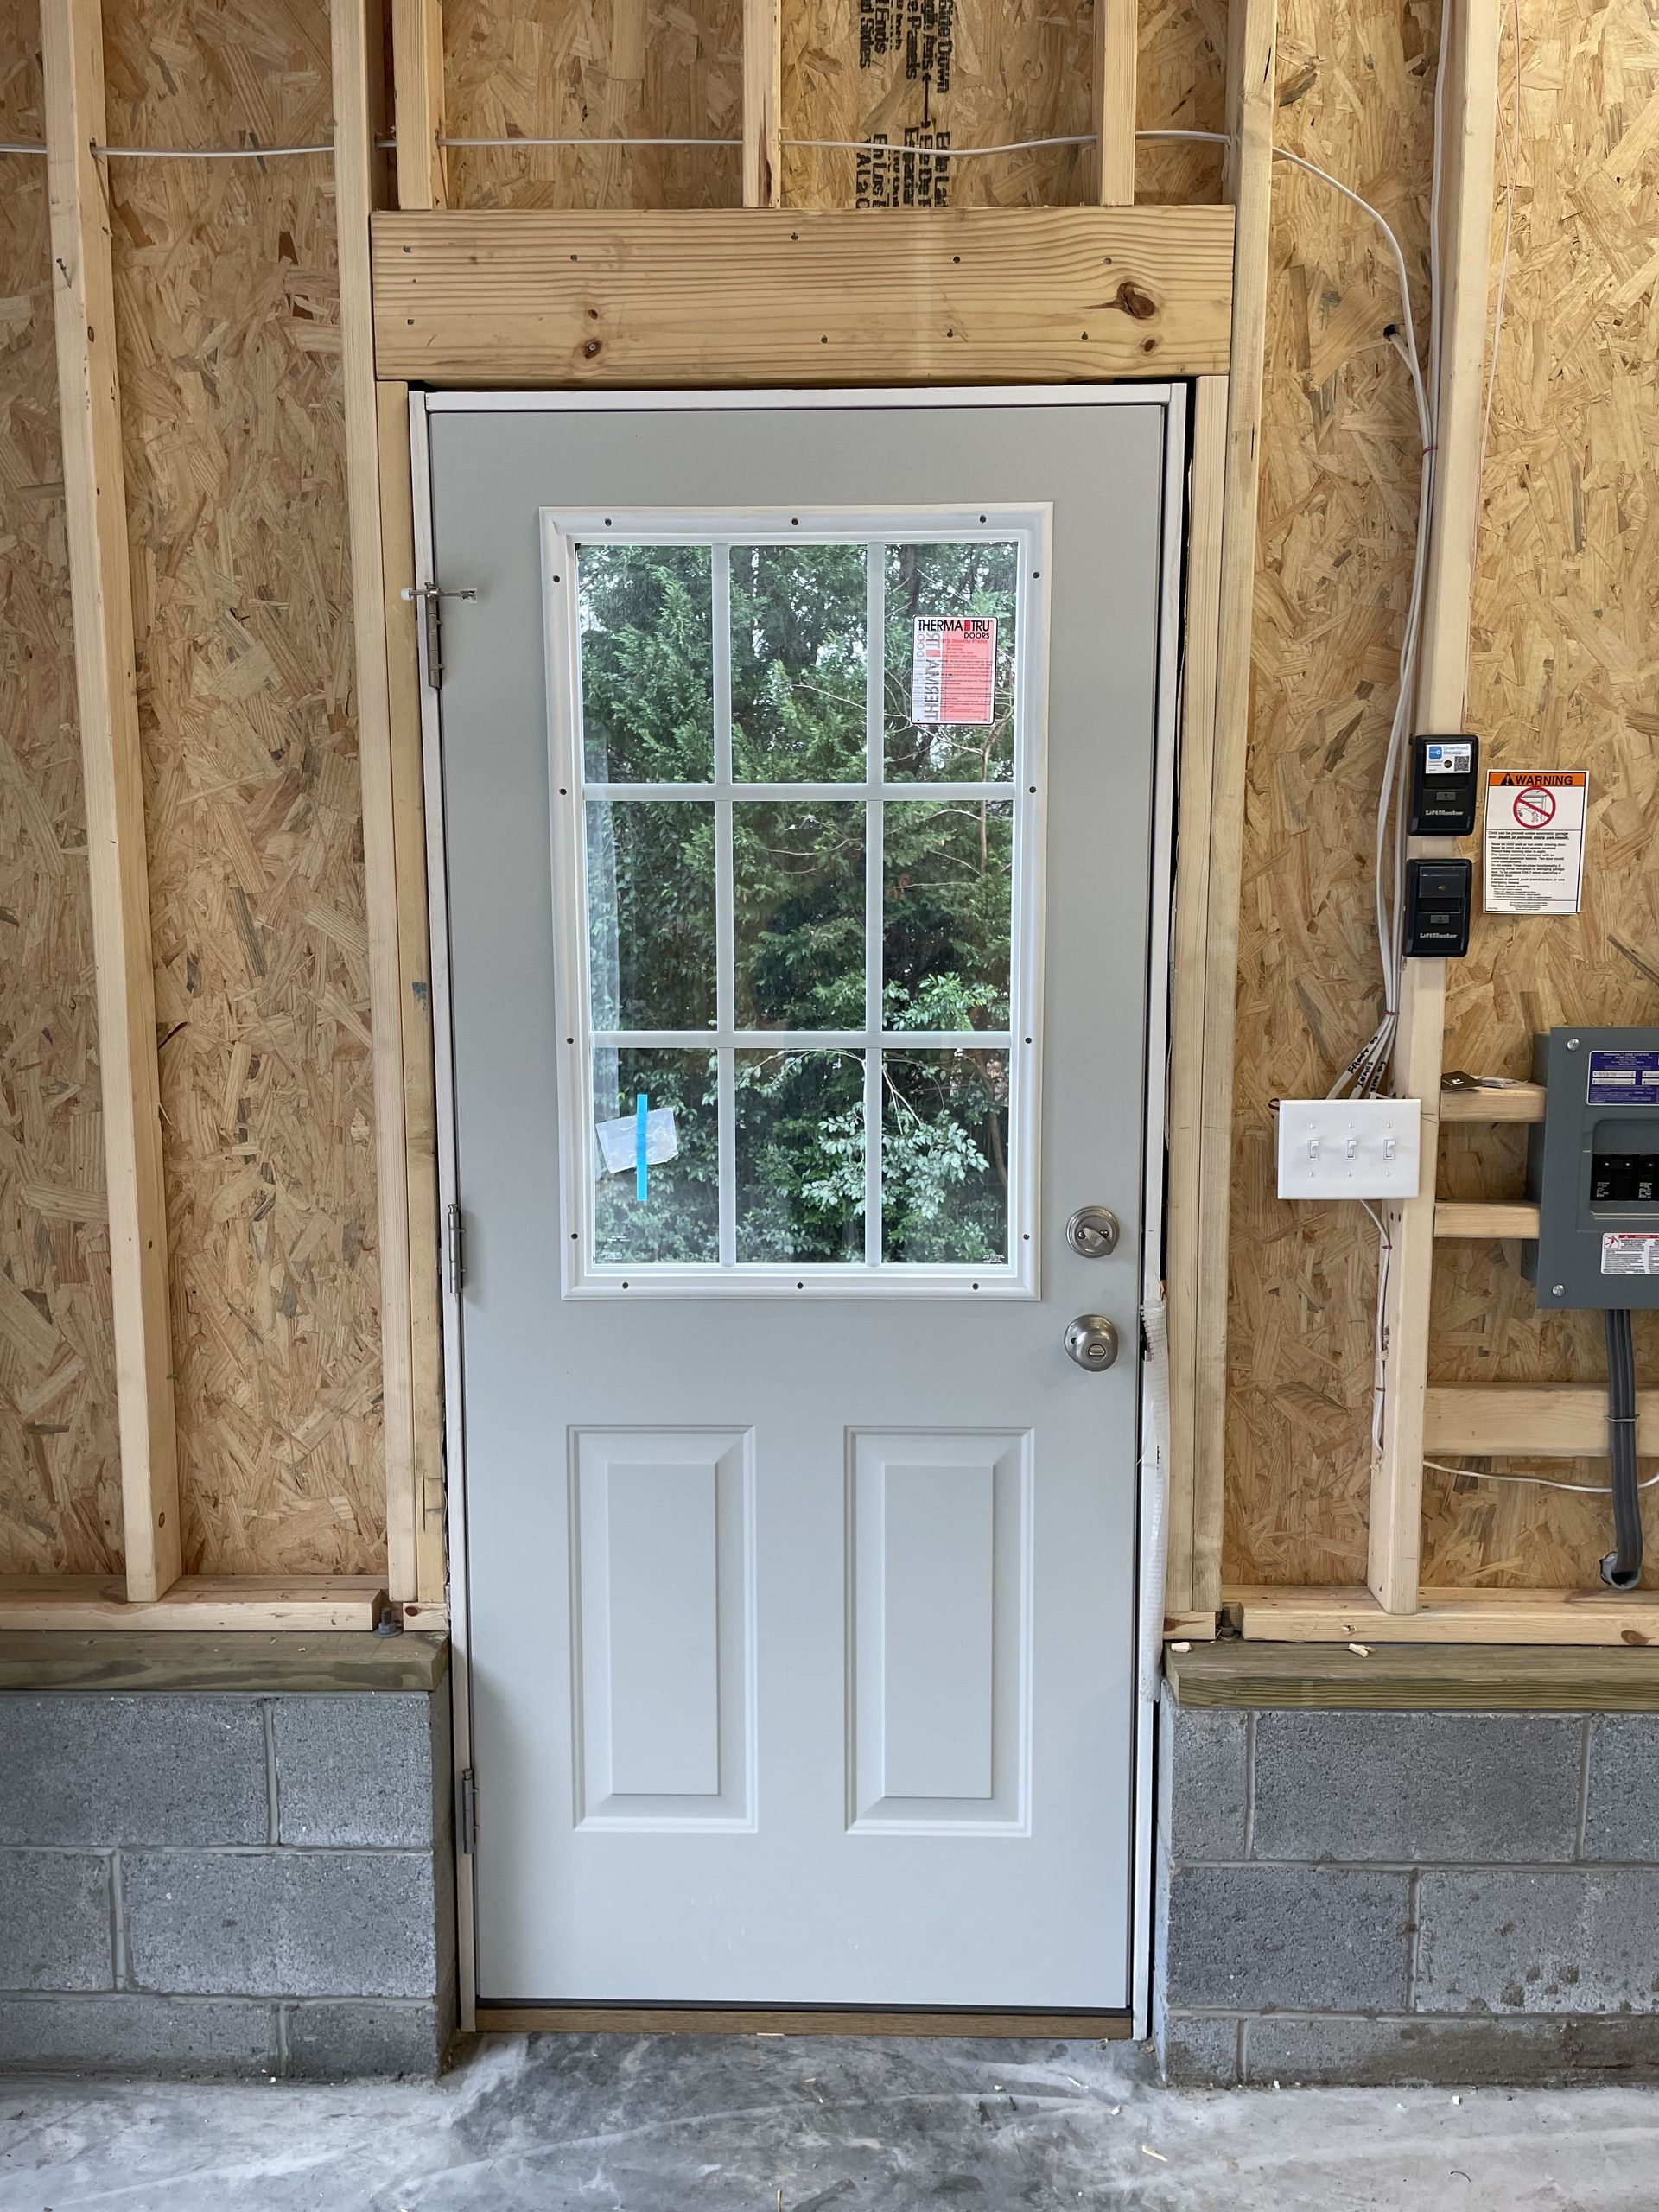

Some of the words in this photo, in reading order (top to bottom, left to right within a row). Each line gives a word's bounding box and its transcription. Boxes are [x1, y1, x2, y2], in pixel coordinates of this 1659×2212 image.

[860, 17, 874, 69] Sides
[874, 7, 889, 54] Ends
[937, 41, 953, 93] Down
[872, 162, 887, 196] Los
[918, 620, 963, 632] THERMA
[971, 620, 990, 632] TRU
[1515, 775, 1573, 785] WARNING
[1348, 1047, 1370, 1074] FRONT
